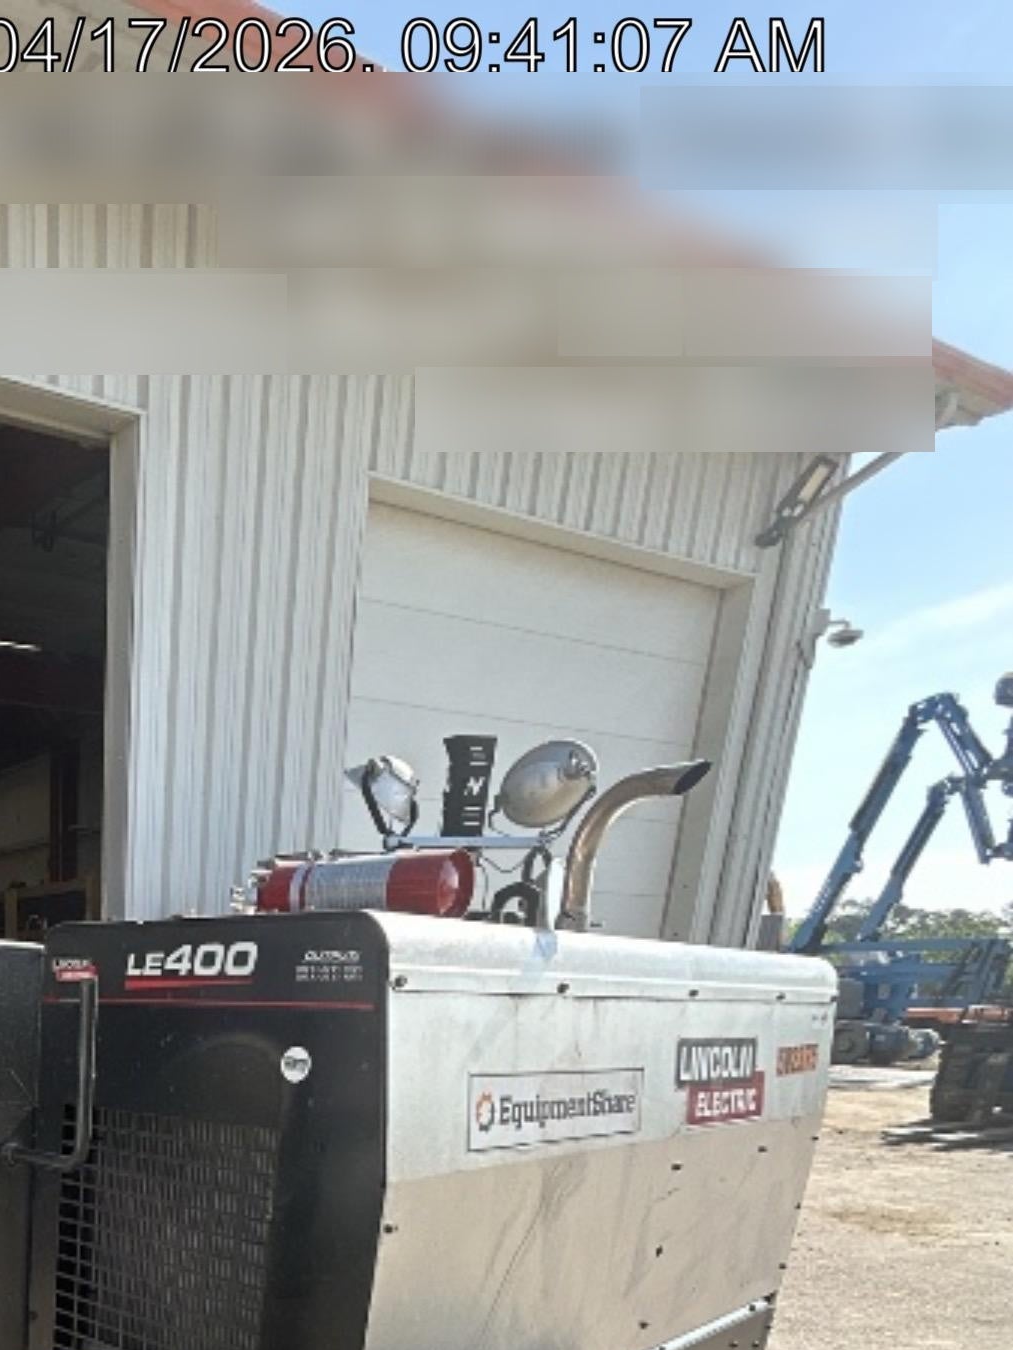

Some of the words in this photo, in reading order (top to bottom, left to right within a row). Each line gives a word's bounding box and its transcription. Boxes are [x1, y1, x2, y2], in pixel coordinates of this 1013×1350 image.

[125, 941, 259, 977] LE400
[679, 1045, 754, 1081] LINCOLN
[499, 1088, 636, 1129] EquipmentShare
[695, 1087, 757, 1118] ELECTRIC
